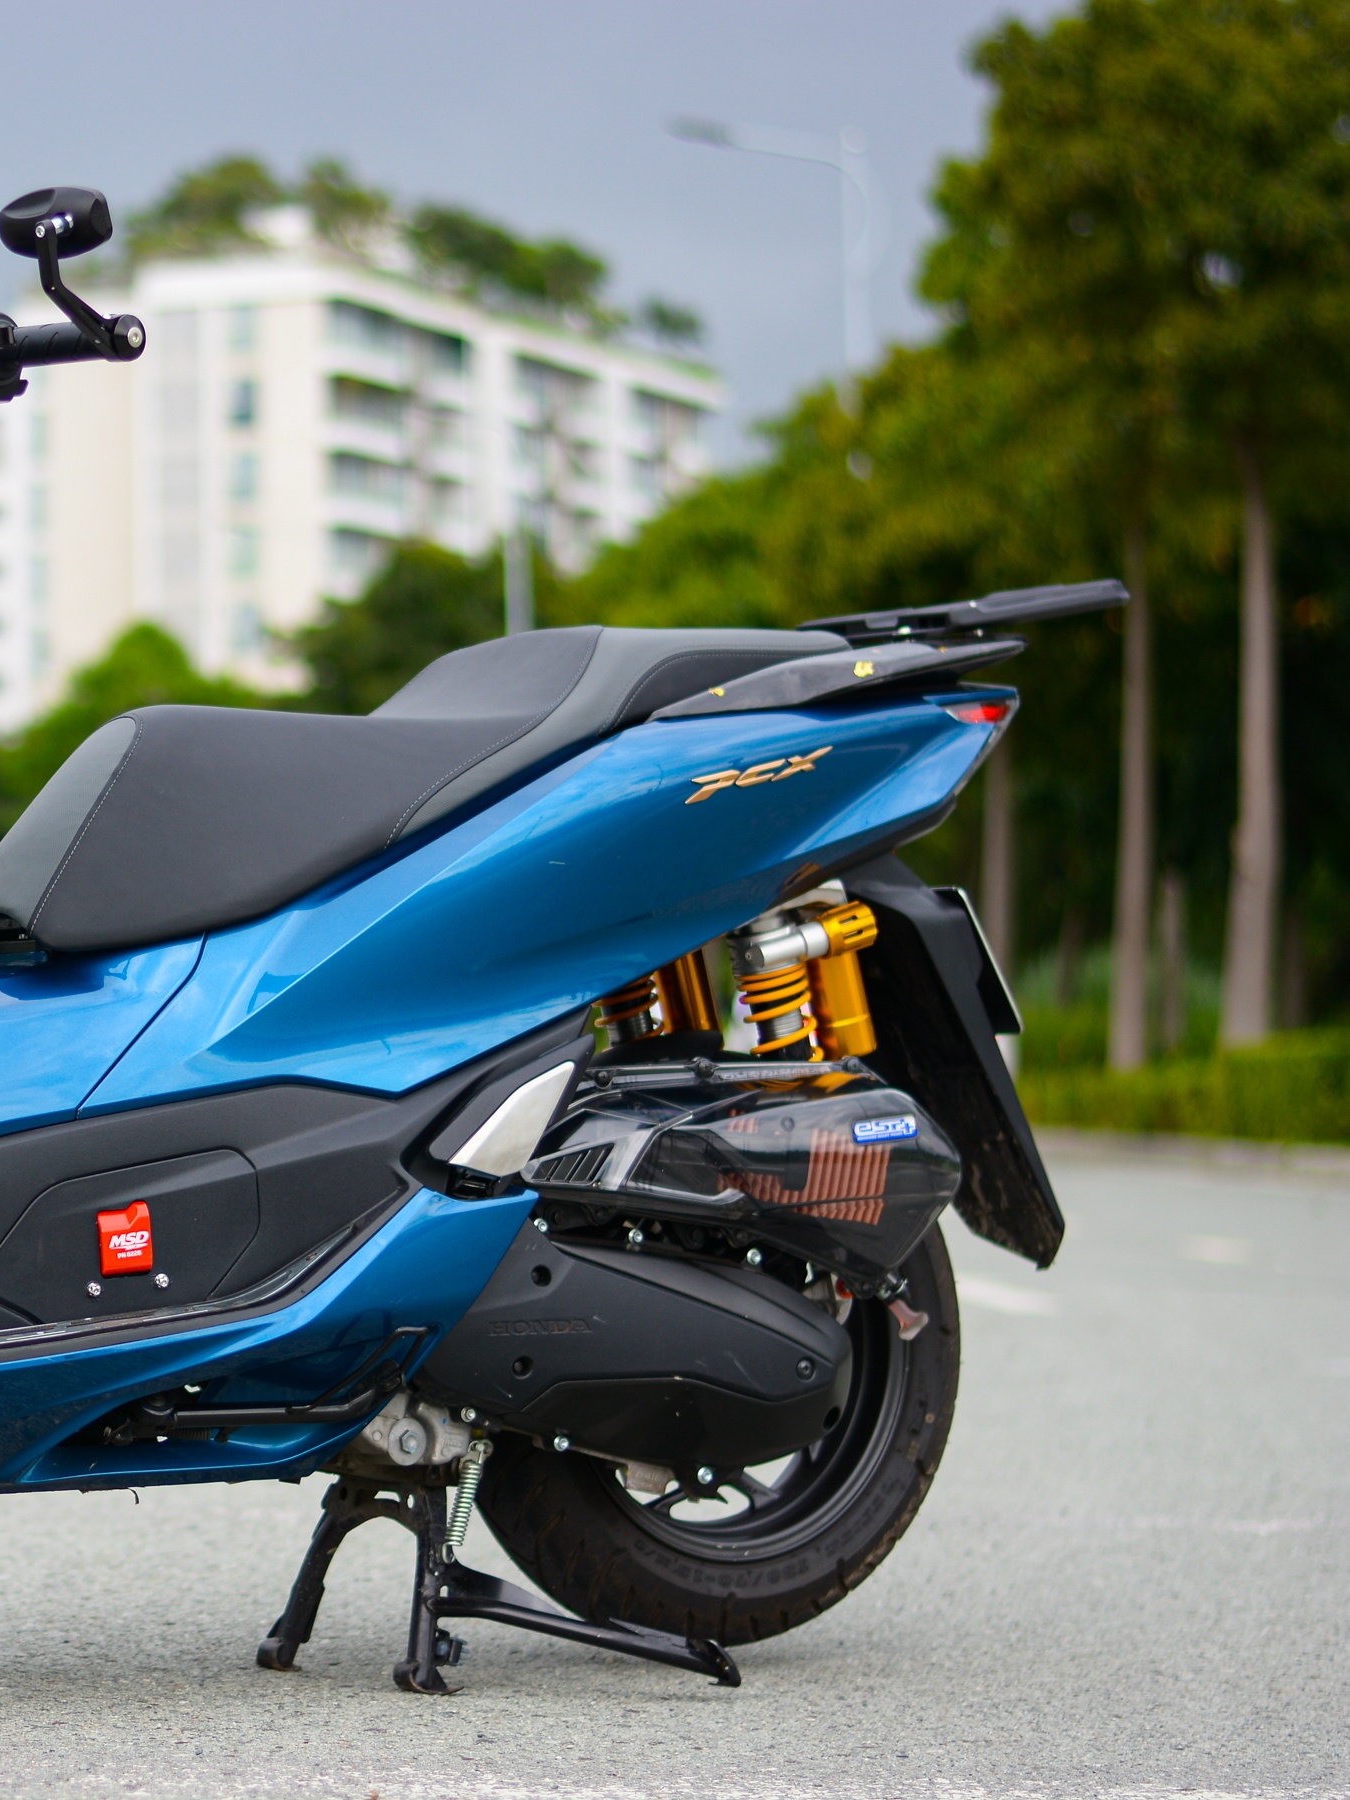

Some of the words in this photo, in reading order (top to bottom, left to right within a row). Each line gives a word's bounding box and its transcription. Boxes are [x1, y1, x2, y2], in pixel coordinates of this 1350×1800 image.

[684, 745, 833, 805] PCX
[109, 1231, 149, 1249] MSD
[488, 1319, 592, 1336] HONDA
